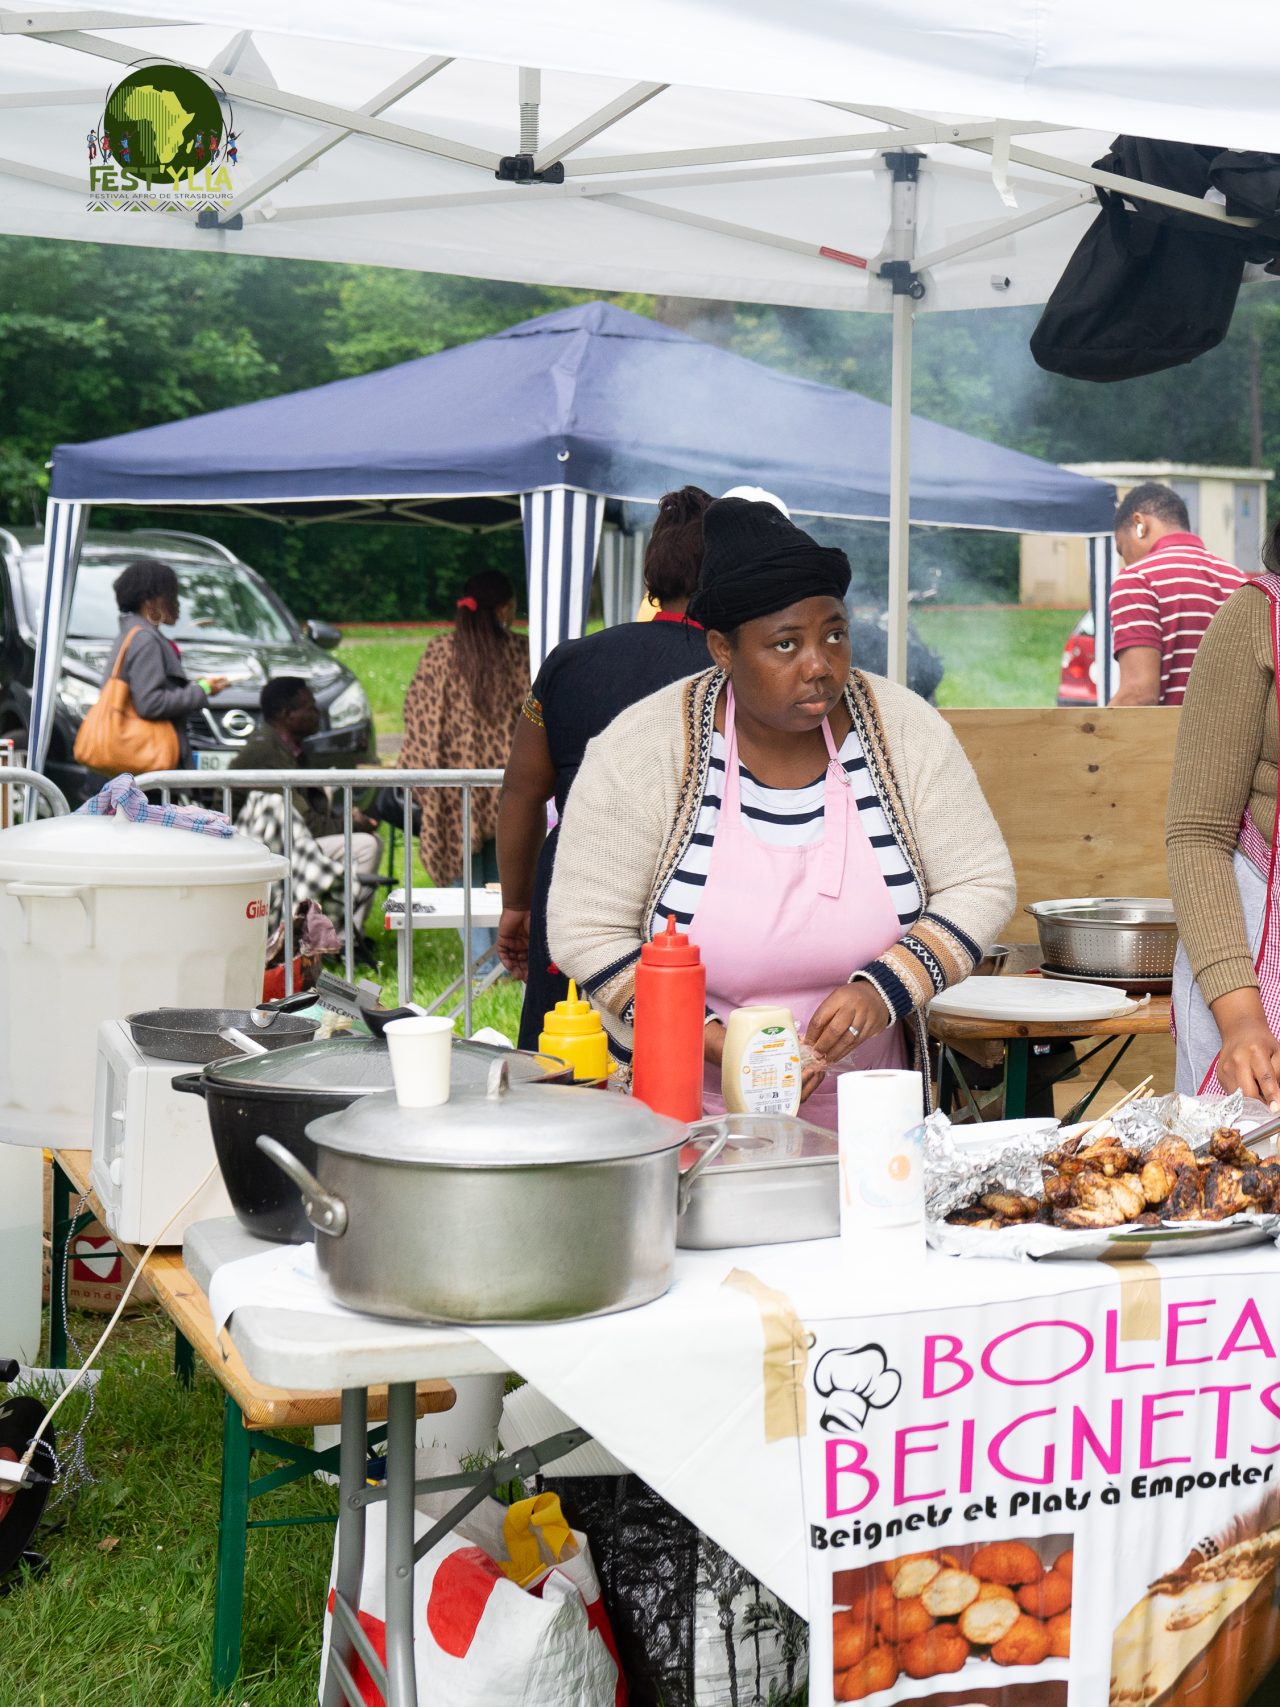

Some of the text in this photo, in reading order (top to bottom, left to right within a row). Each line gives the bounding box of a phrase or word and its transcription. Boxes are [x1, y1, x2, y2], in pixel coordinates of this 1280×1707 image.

[811, 1464, 1273, 1550] Beignets et Plats à Emporter
